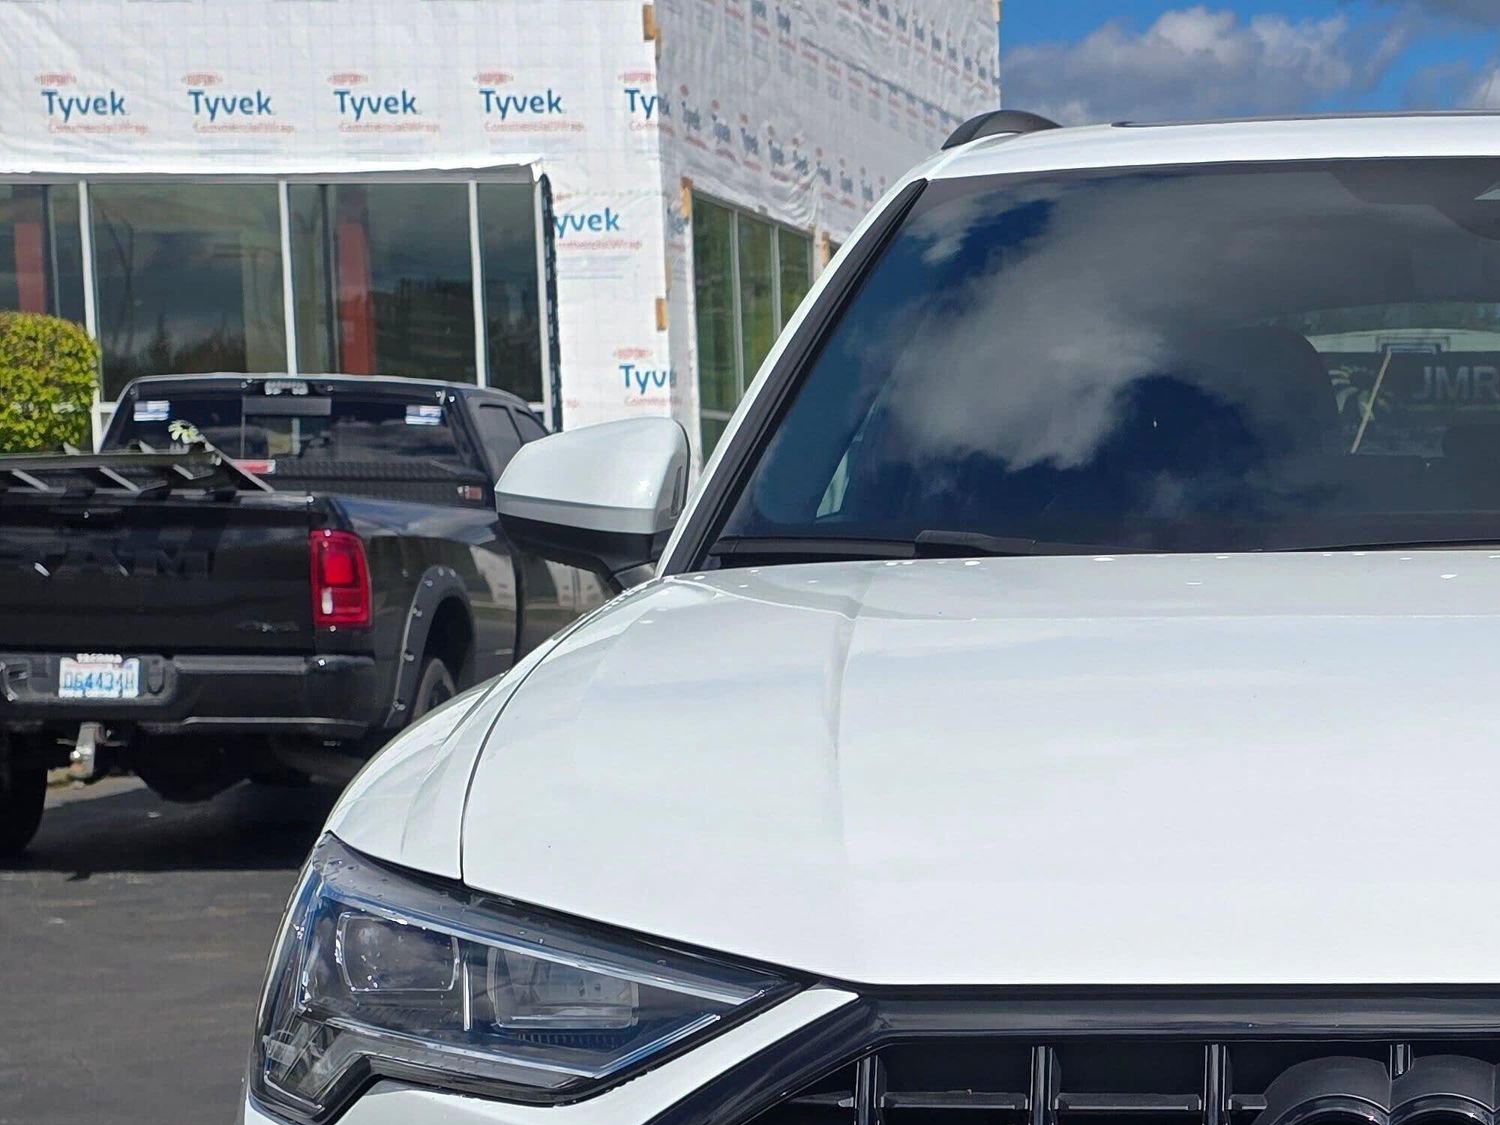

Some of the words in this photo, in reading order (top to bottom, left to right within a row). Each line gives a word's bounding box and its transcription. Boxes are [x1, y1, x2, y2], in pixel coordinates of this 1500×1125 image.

[41, 89, 127, 122] Tyvek
[188, 88, 273, 122] Tyvek
[334, 88, 418, 120] Tyvek
[480, 88, 564, 120] Tyvek
[553, 207, 621, 239] yvek
[619, 364, 677, 395] Tyv
